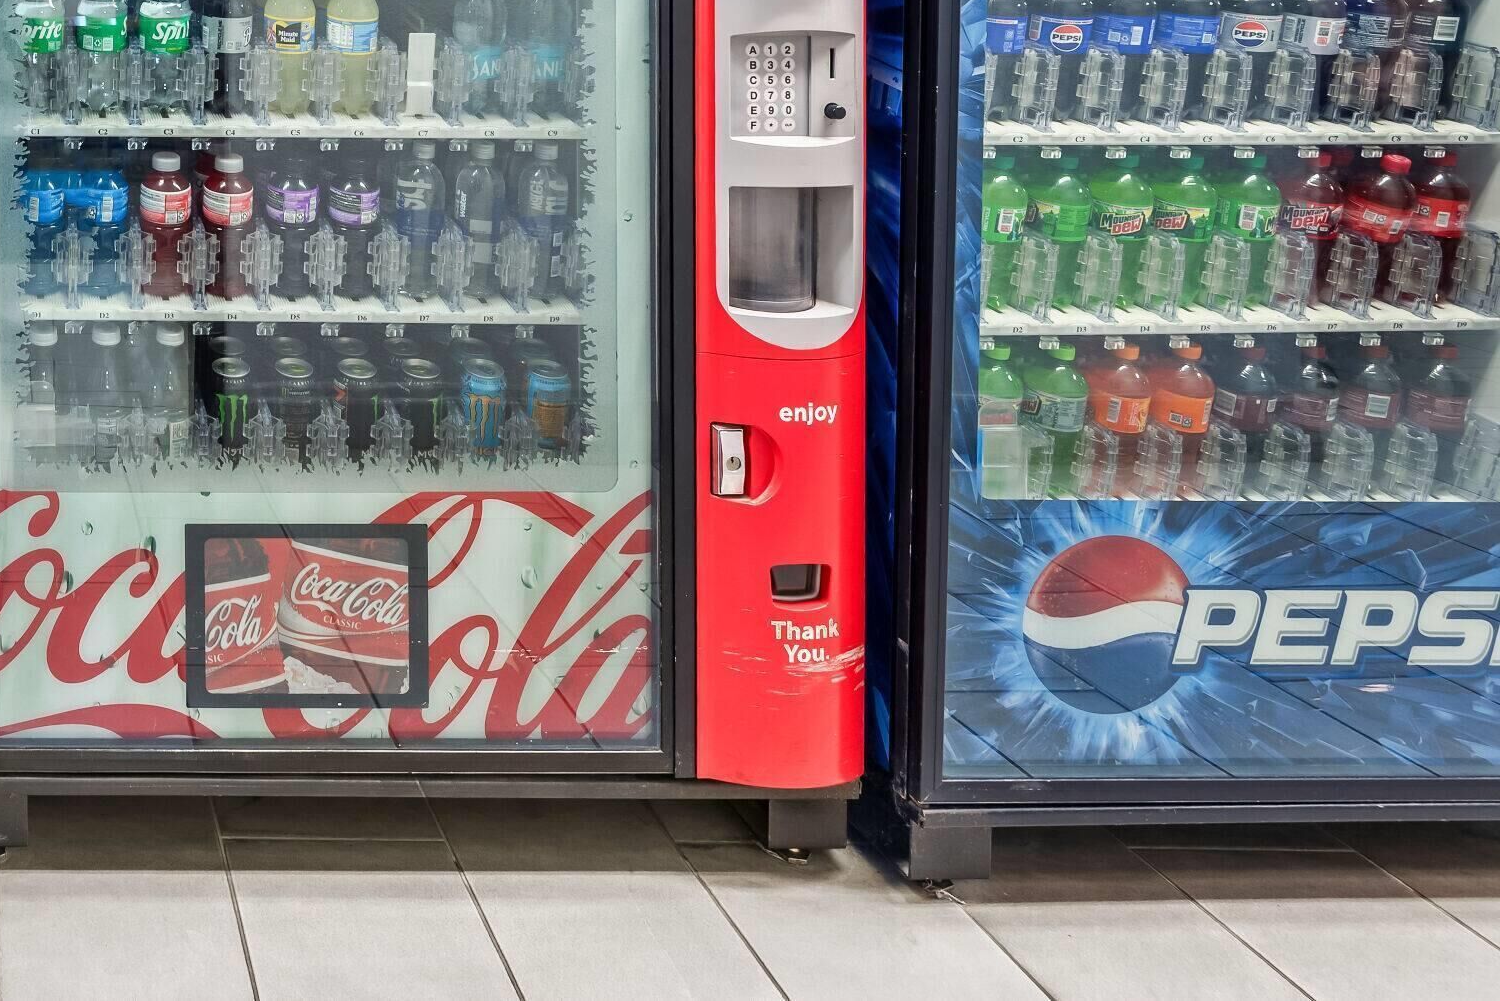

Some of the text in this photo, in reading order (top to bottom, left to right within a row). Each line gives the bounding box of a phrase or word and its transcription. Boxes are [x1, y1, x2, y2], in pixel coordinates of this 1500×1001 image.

[21, 20, 63, 42] prite
[1233, 29, 1267, 39] PEPSI
[1051, 33, 1082, 43] PEPSI
[749, 46, 757, 55] A
[767, 46, 773, 55] 1
[784, 46, 791, 55] 2
[749, 61, 757, 70] B
[767, 61, 773, 69] 3
[784, 61, 791, 69] 4
[749, 76, 757, 85] C
[767, 76, 773, 84] 5
[784, 76, 791, 84] 6
[750, 91, 757, 100] D
[767, 91, 774, 99] 7
[784, 91, 791, 99] 8
[750, 106, 757, 115] E
[768, 106, 774, 115] 9
[750, 121, 757, 130] F
[354, 129, 364, 137] C6
[484, 129, 495, 137] C8
[1328, 135, 1338, 143] C7
[1282, 206, 1329, 218] MOUNTAIN
[1100, 212, 1142, 228] MOUNTAIN
[1155, 216, 1187, 230] DEW
[1291, 212, 1329, 229] DEW
[1111, 218, 1143, 236] DEW
[100, 312, 110, 320] D2
[227, 313, 238, 321] D4
[1012, 326, 1023, 334] D2
[778, 401, 838, 426] enjoy
[290, 562, 408, 625] Coca-Cola
[323, 614, 363, 630] CLASSIC
[771, 617, 840, 641] Thank
[1171, 588, 1500, 667] PEPS
